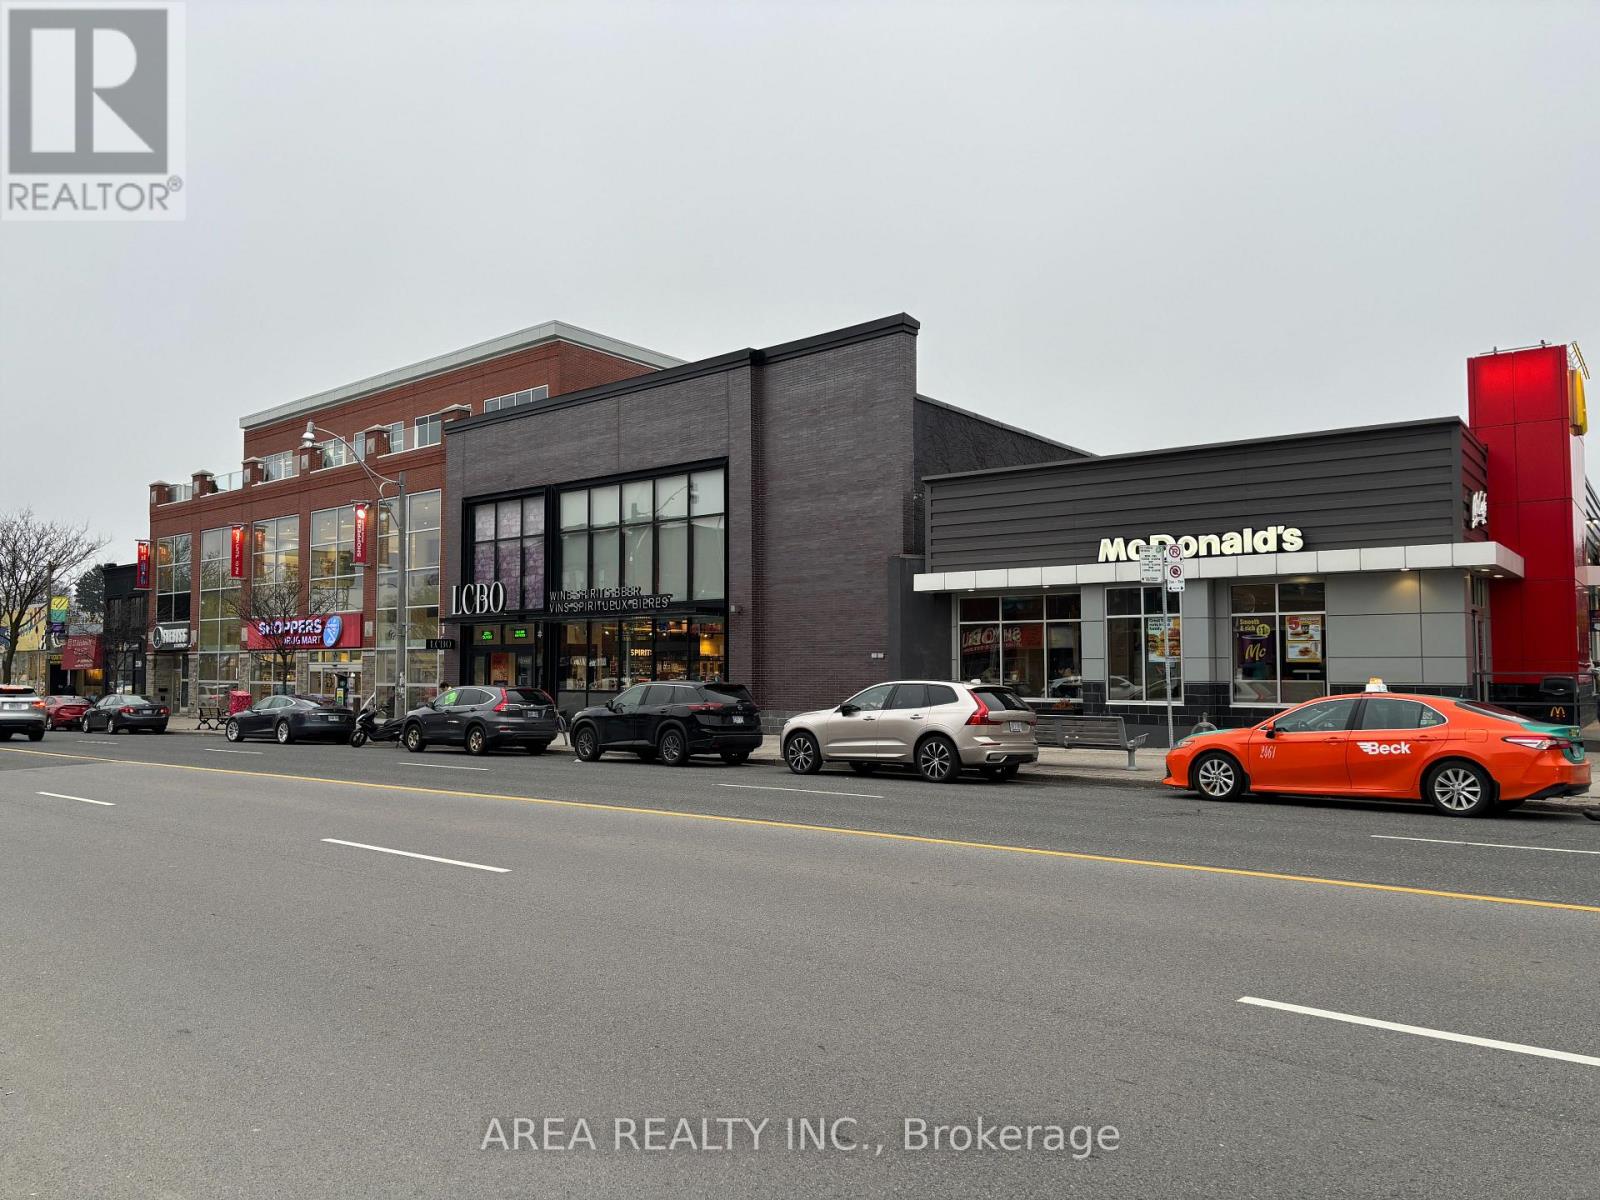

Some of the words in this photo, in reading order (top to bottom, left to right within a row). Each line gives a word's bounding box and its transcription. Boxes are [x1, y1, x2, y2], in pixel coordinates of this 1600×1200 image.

[452, 581, 504, 615] LCBO
[259, 618, 322, 635] SHOPPERS
[302, 635, 321, 645] MART
[1359, 741, 1411, 755] Beck
